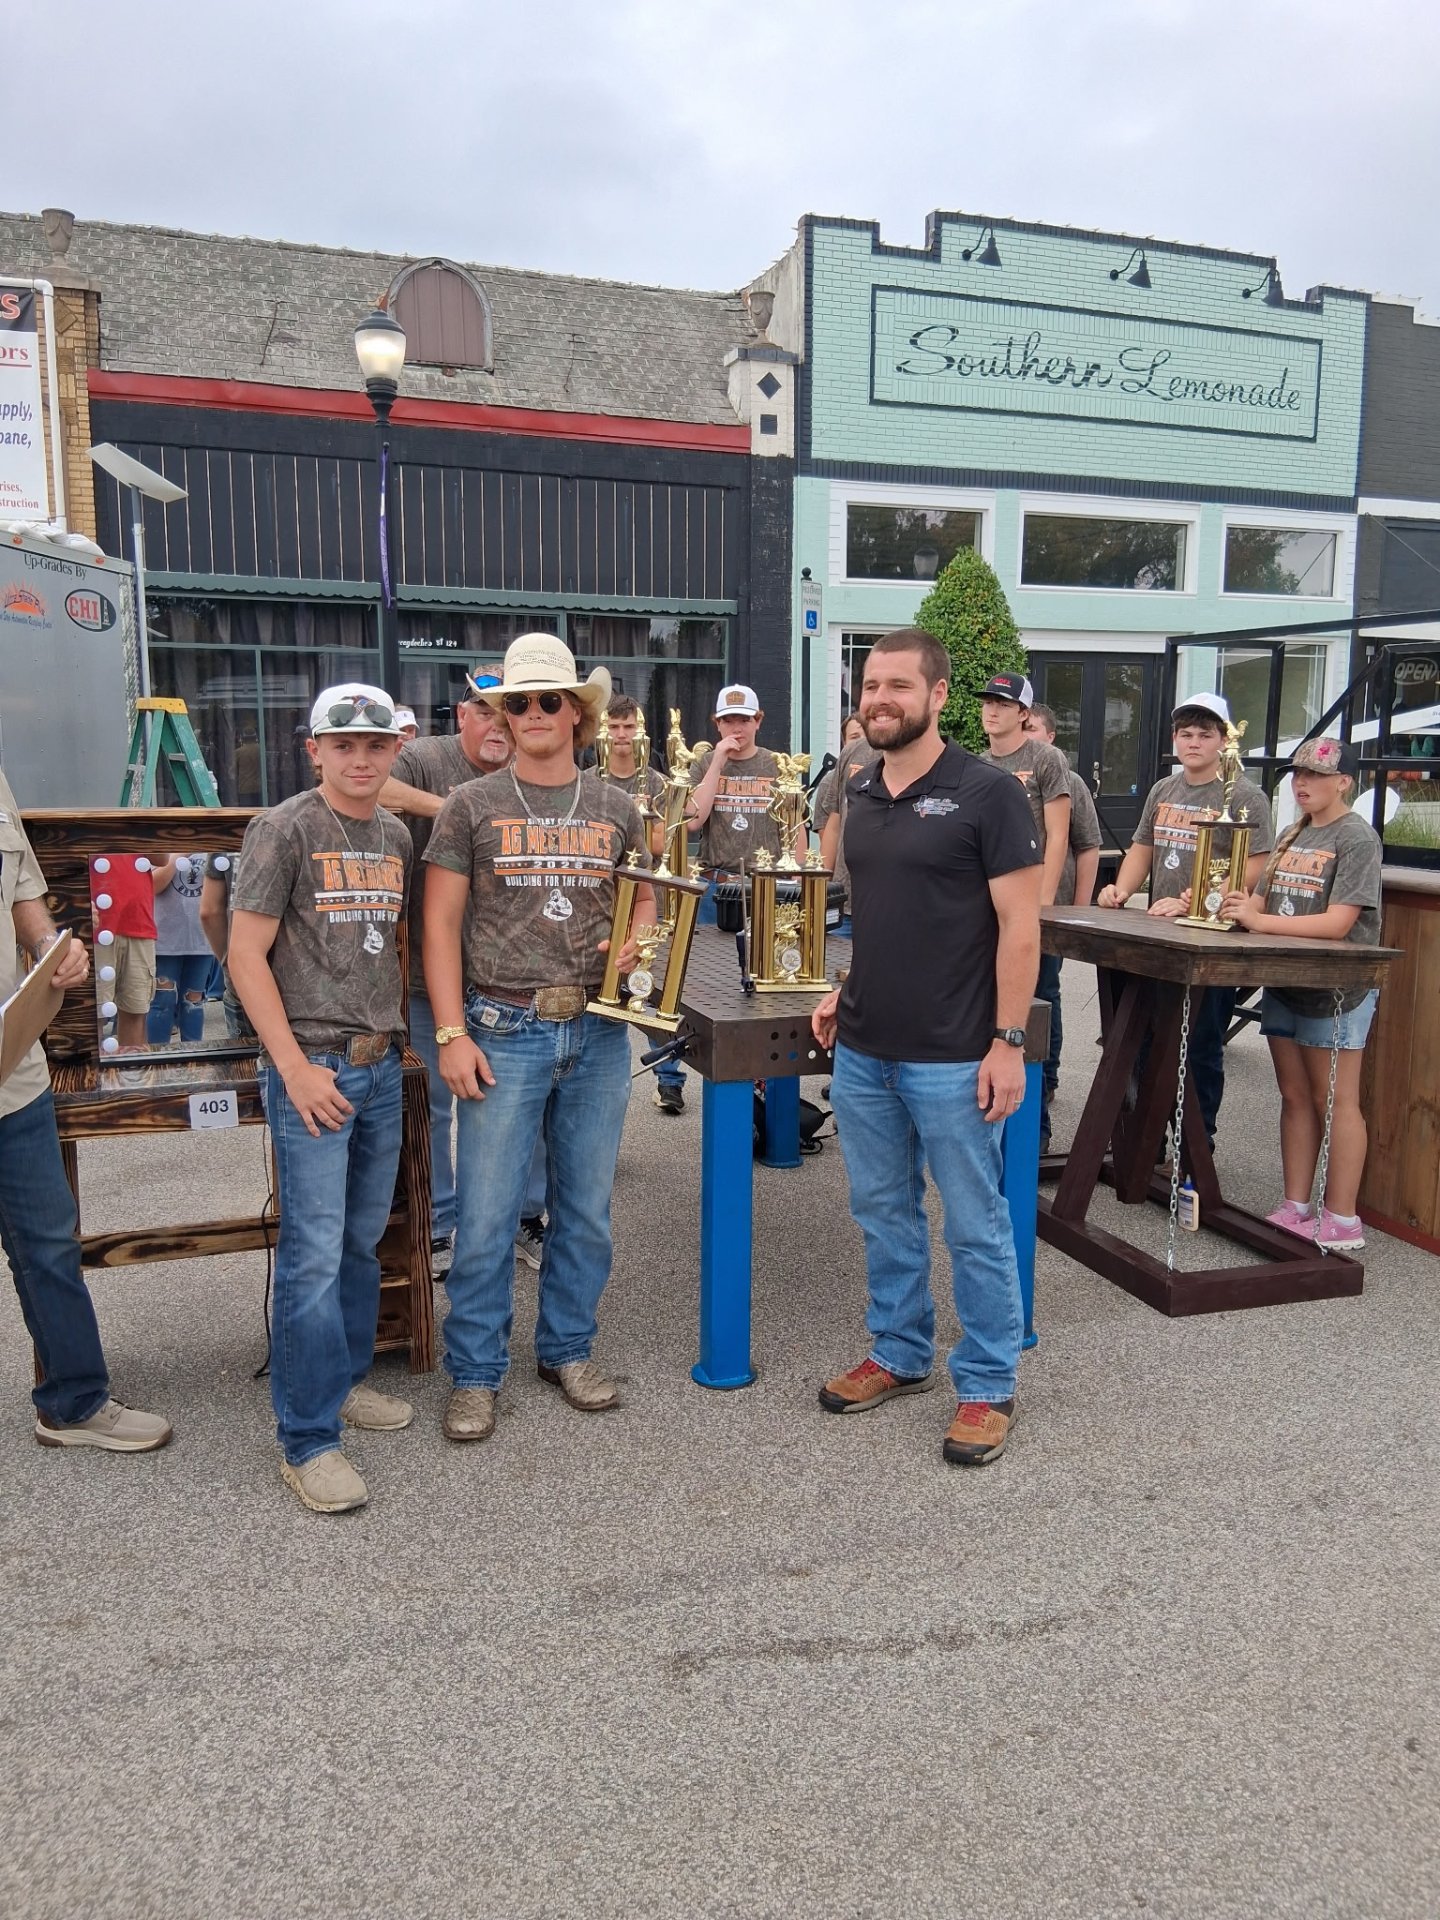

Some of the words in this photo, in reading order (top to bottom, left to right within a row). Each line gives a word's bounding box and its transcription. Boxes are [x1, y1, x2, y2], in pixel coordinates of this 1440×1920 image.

[896, 324, 1113, 387] Southern
[1119, 347, 1300, 411] Lemonade
[0, 401, 32, 421] pply,
[24, 554, 73, 575] Up-Grades
[76, 566, 86, 580] By
[69, 597, 99, 620] CHI
[1394, 662, 1433, 680] OPEN
[501, 826, 521, 854] AG
[526, 826, 611, 858] MECHANICS
[505, 875, 542, 886] BUILDING
[545, 875, 560, 886] FOR
[562, 875, 576, 887] THE
[637, 924, 670, 942] 2026
[199, 1099, 229, 1114] 403
